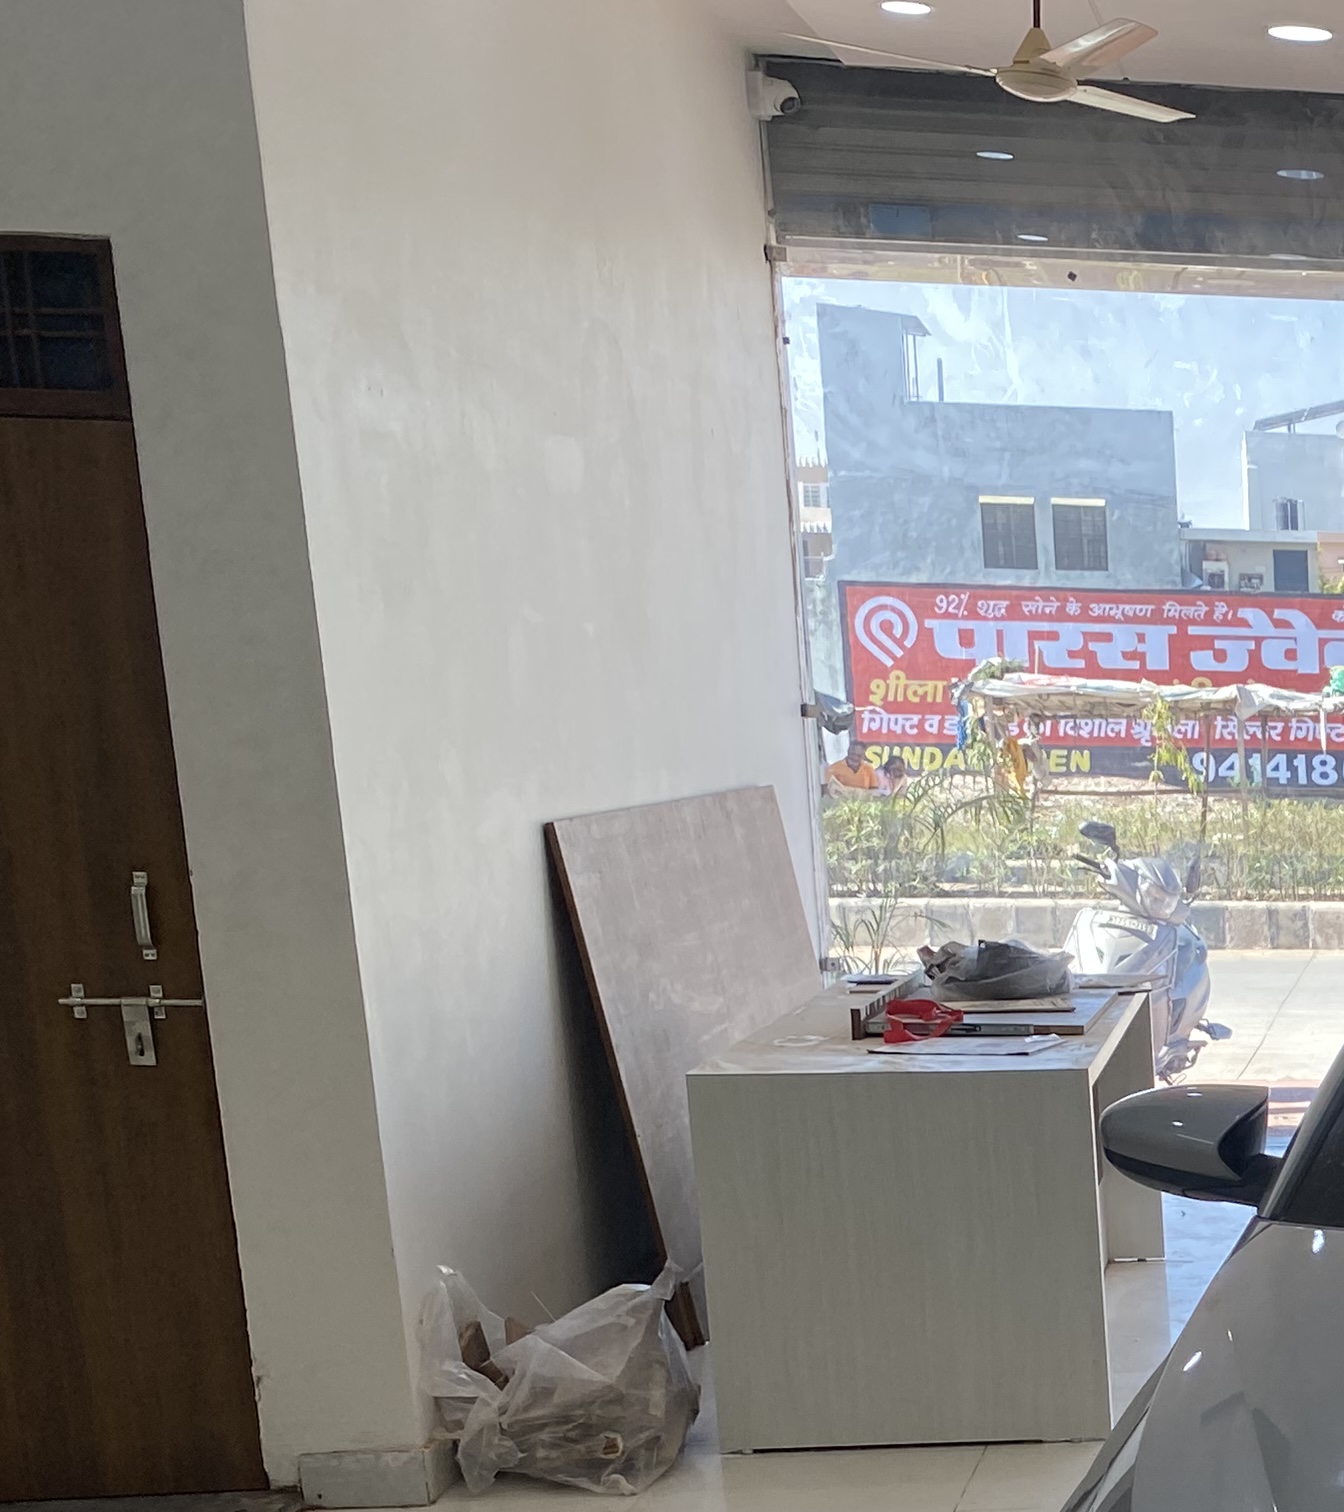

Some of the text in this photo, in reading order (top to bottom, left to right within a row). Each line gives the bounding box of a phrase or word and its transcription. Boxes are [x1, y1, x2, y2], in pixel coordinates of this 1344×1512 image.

[934, 592, 970, 617] 92%
[1021, 596, 1060, 616] सोने
[1065, 597, 1082, 617] के
[1088, 602, 1155, 621] आभूषण
[1162, 600, 1209, 620] मिलते
[925, 619, 1177, 674] पारस
[861, 709, 921, 735] गिफ्ट
[924, 714, 941, 735] व
